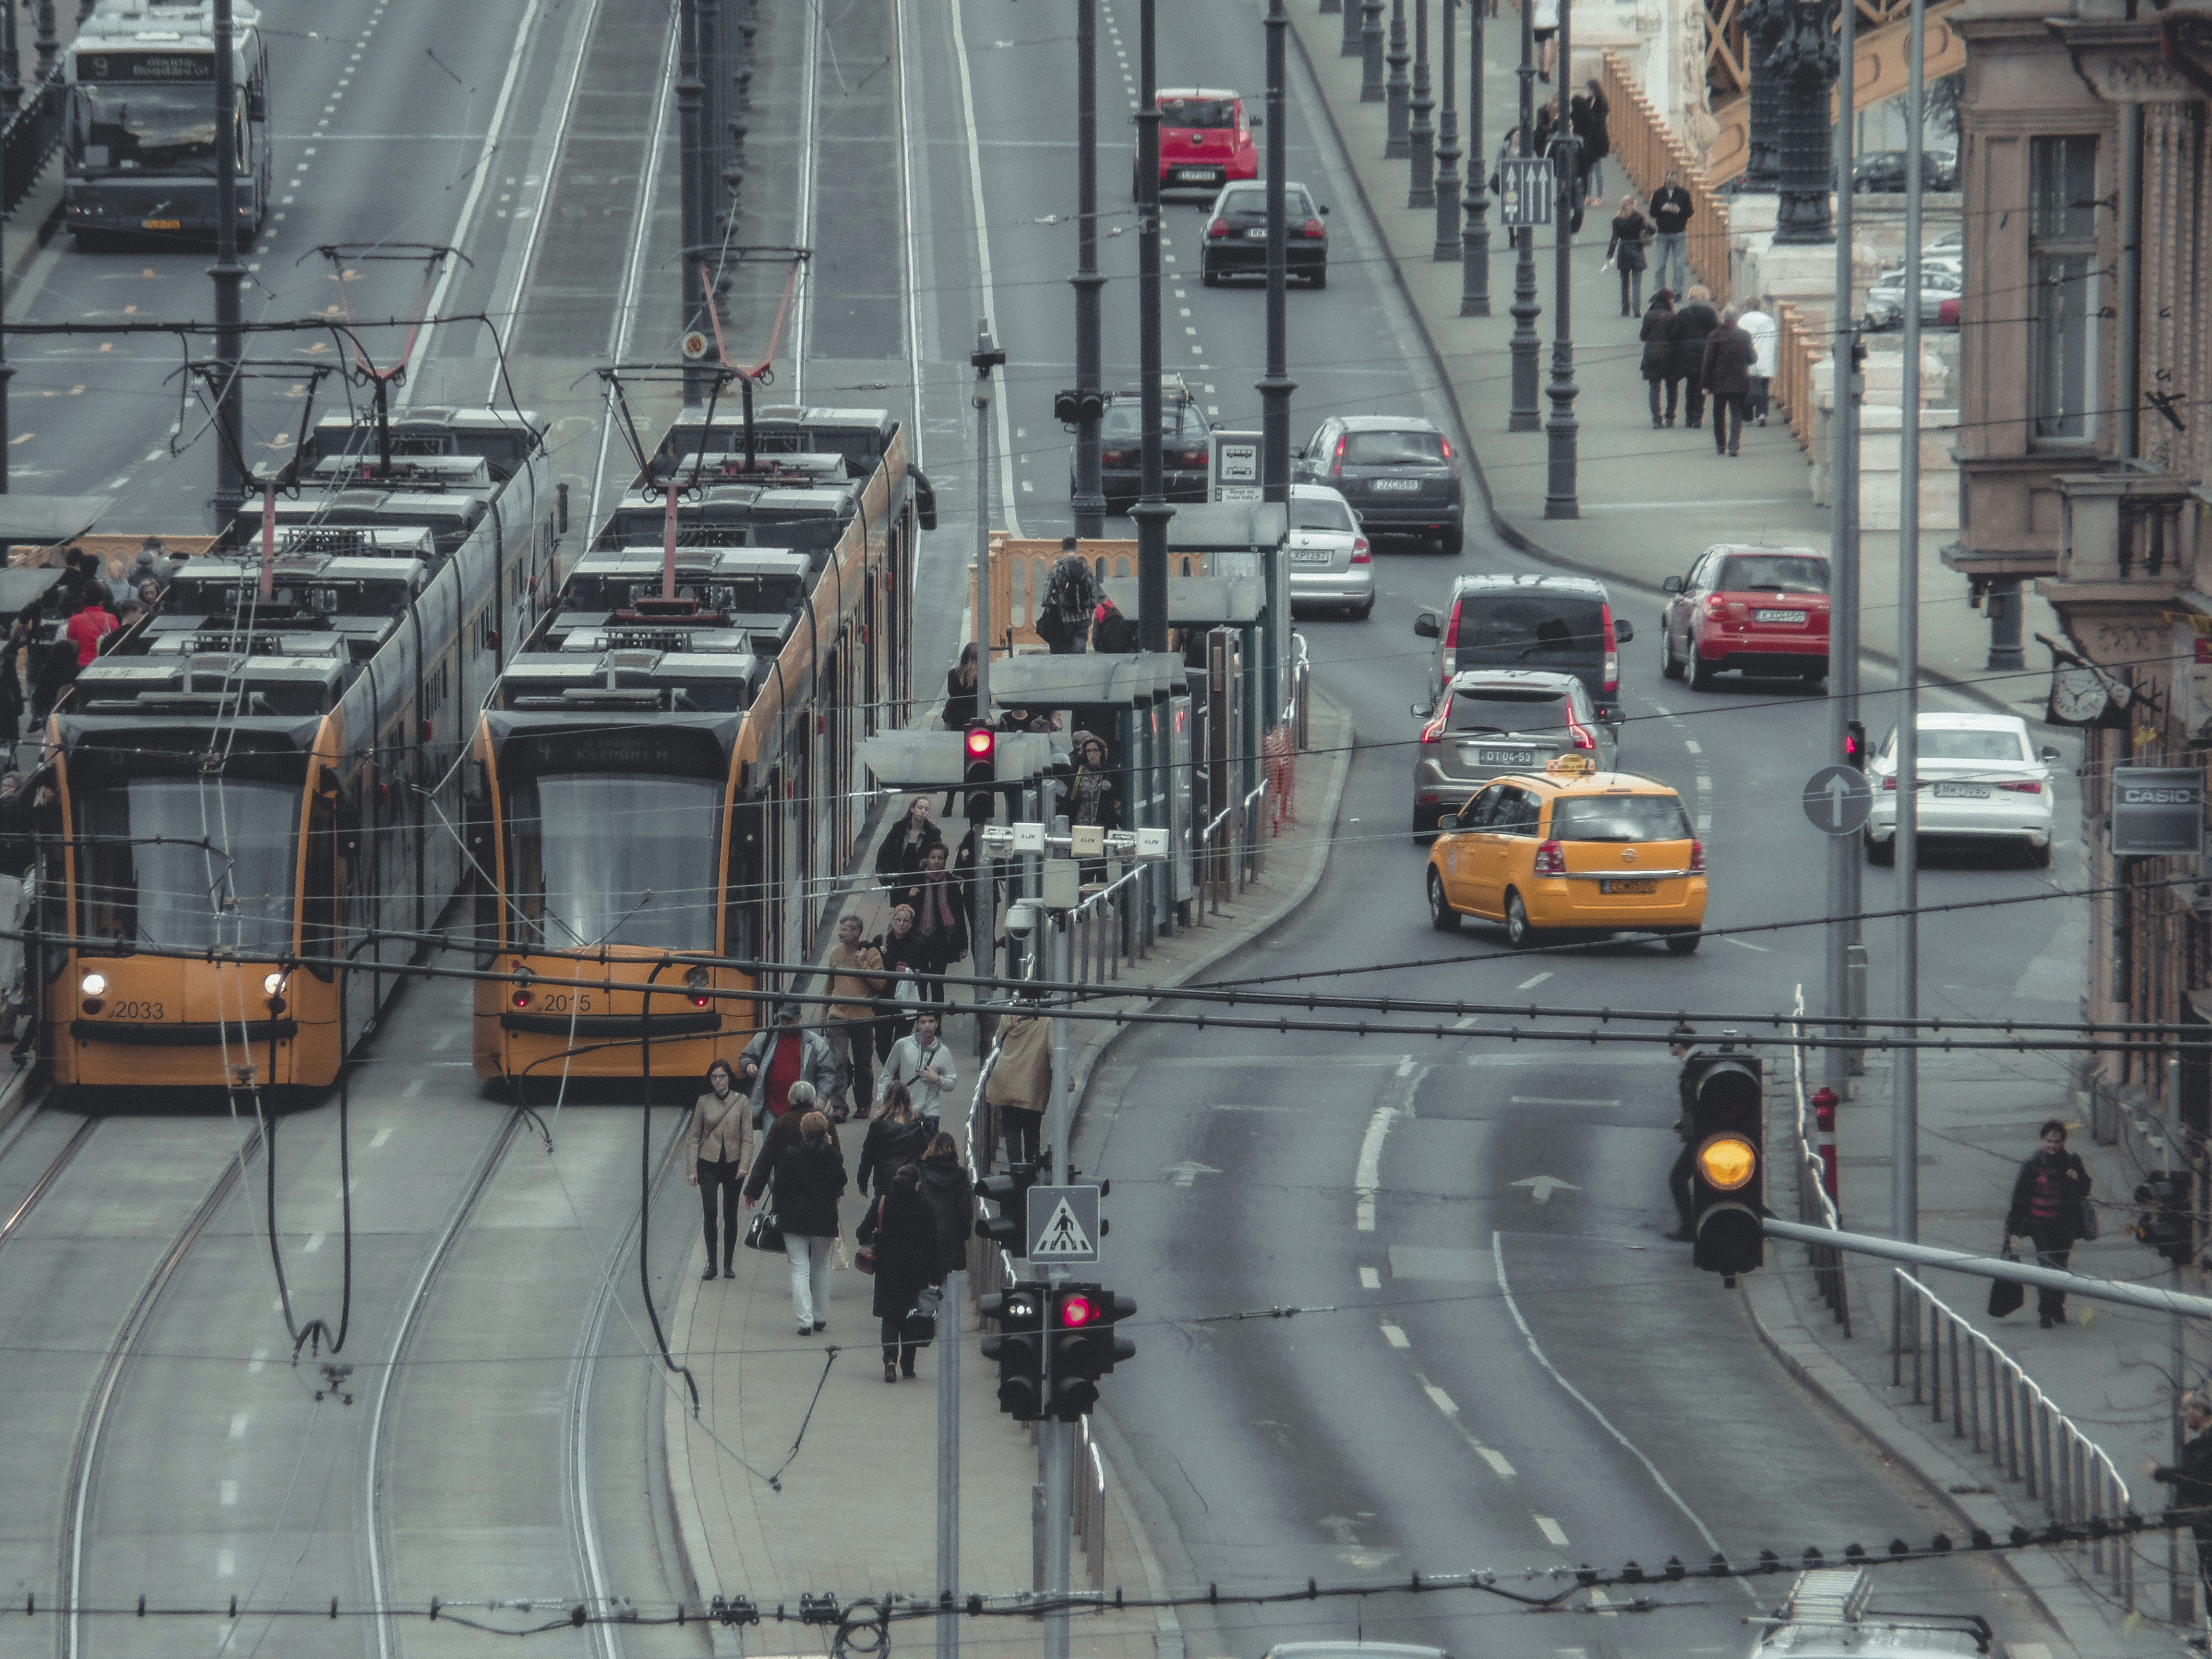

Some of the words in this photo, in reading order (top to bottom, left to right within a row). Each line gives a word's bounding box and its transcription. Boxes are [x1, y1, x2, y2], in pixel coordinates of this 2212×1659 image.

[94, 57, 108, 76] 9
[1486, 751, 1501, 761] DT
[1502, 751, 1531, 762] 04-53
[2125, 790, 2190, 803] CASIO
[115, 1001, 164, 1020] 2033
